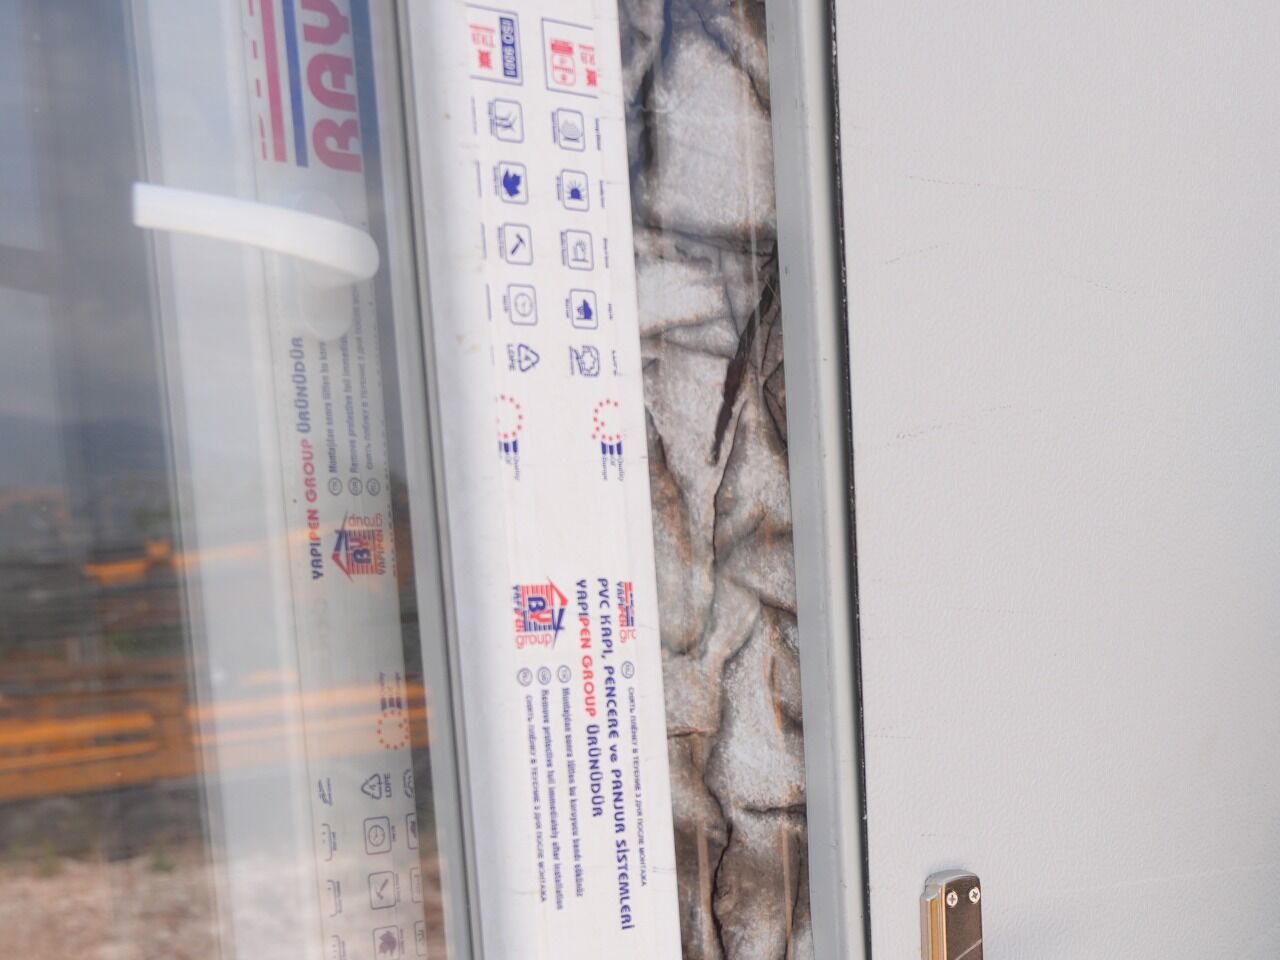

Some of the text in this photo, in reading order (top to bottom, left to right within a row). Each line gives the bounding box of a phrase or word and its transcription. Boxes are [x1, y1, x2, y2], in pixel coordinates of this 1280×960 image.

[290, 336, 324, 580] YAPIPEN GROUP ÜRÜNÜDÜR
[515, 633, 554, 650] group
[576, 579, 605, 817] YAPIPEN GROUP ÜRÜNÜDÜR
[598, 578, 635, 930] PVC KAPI, PENCERE ve PANJUR SİSTEMLERİ
